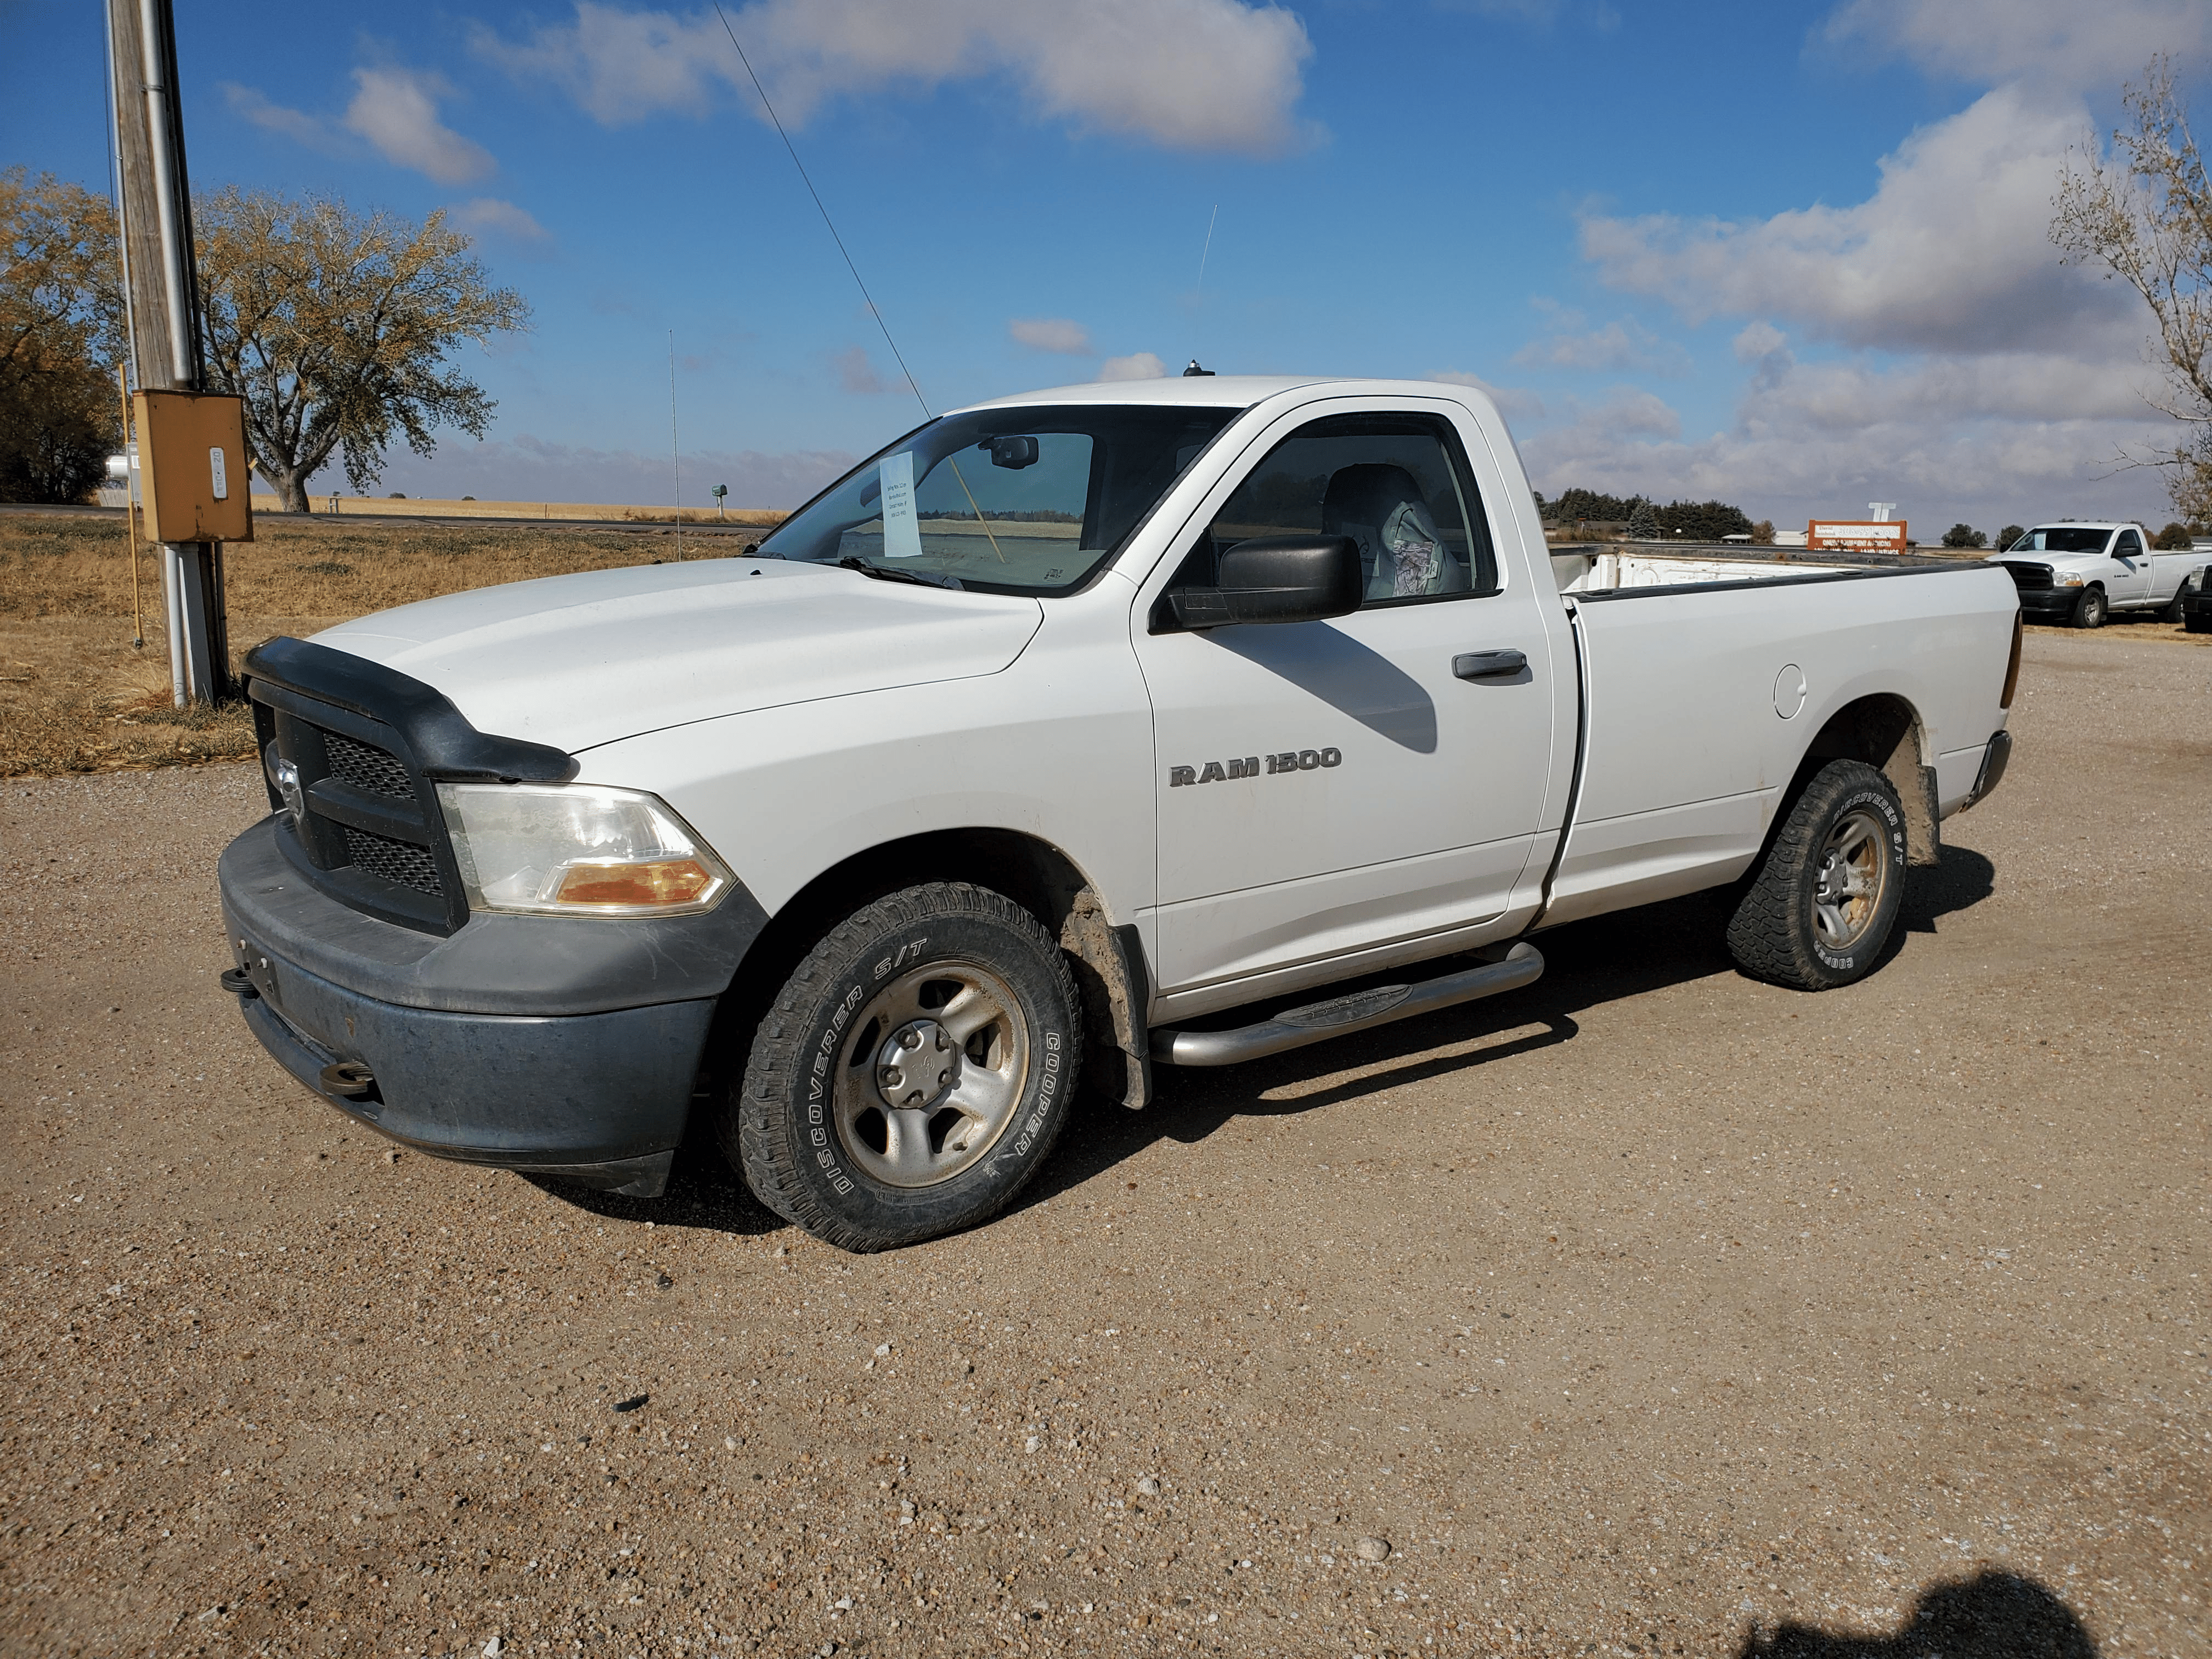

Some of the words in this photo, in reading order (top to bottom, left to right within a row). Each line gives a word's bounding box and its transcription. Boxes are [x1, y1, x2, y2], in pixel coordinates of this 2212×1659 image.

[1169, 755, 1260, 787] RAM
[1264, 747, 1342, 775] 1500
[1833, 792, 1898, 826] DISCOVERER
[1893, 832, 1903, 865] S/T
[1813, 940, 1854, 969] COOPER
[809, 985, 864, 1195] DISCOVERER
[875, 938, 928, 980] S/T
[1015, 1032, 1061, 1156] COOPER
